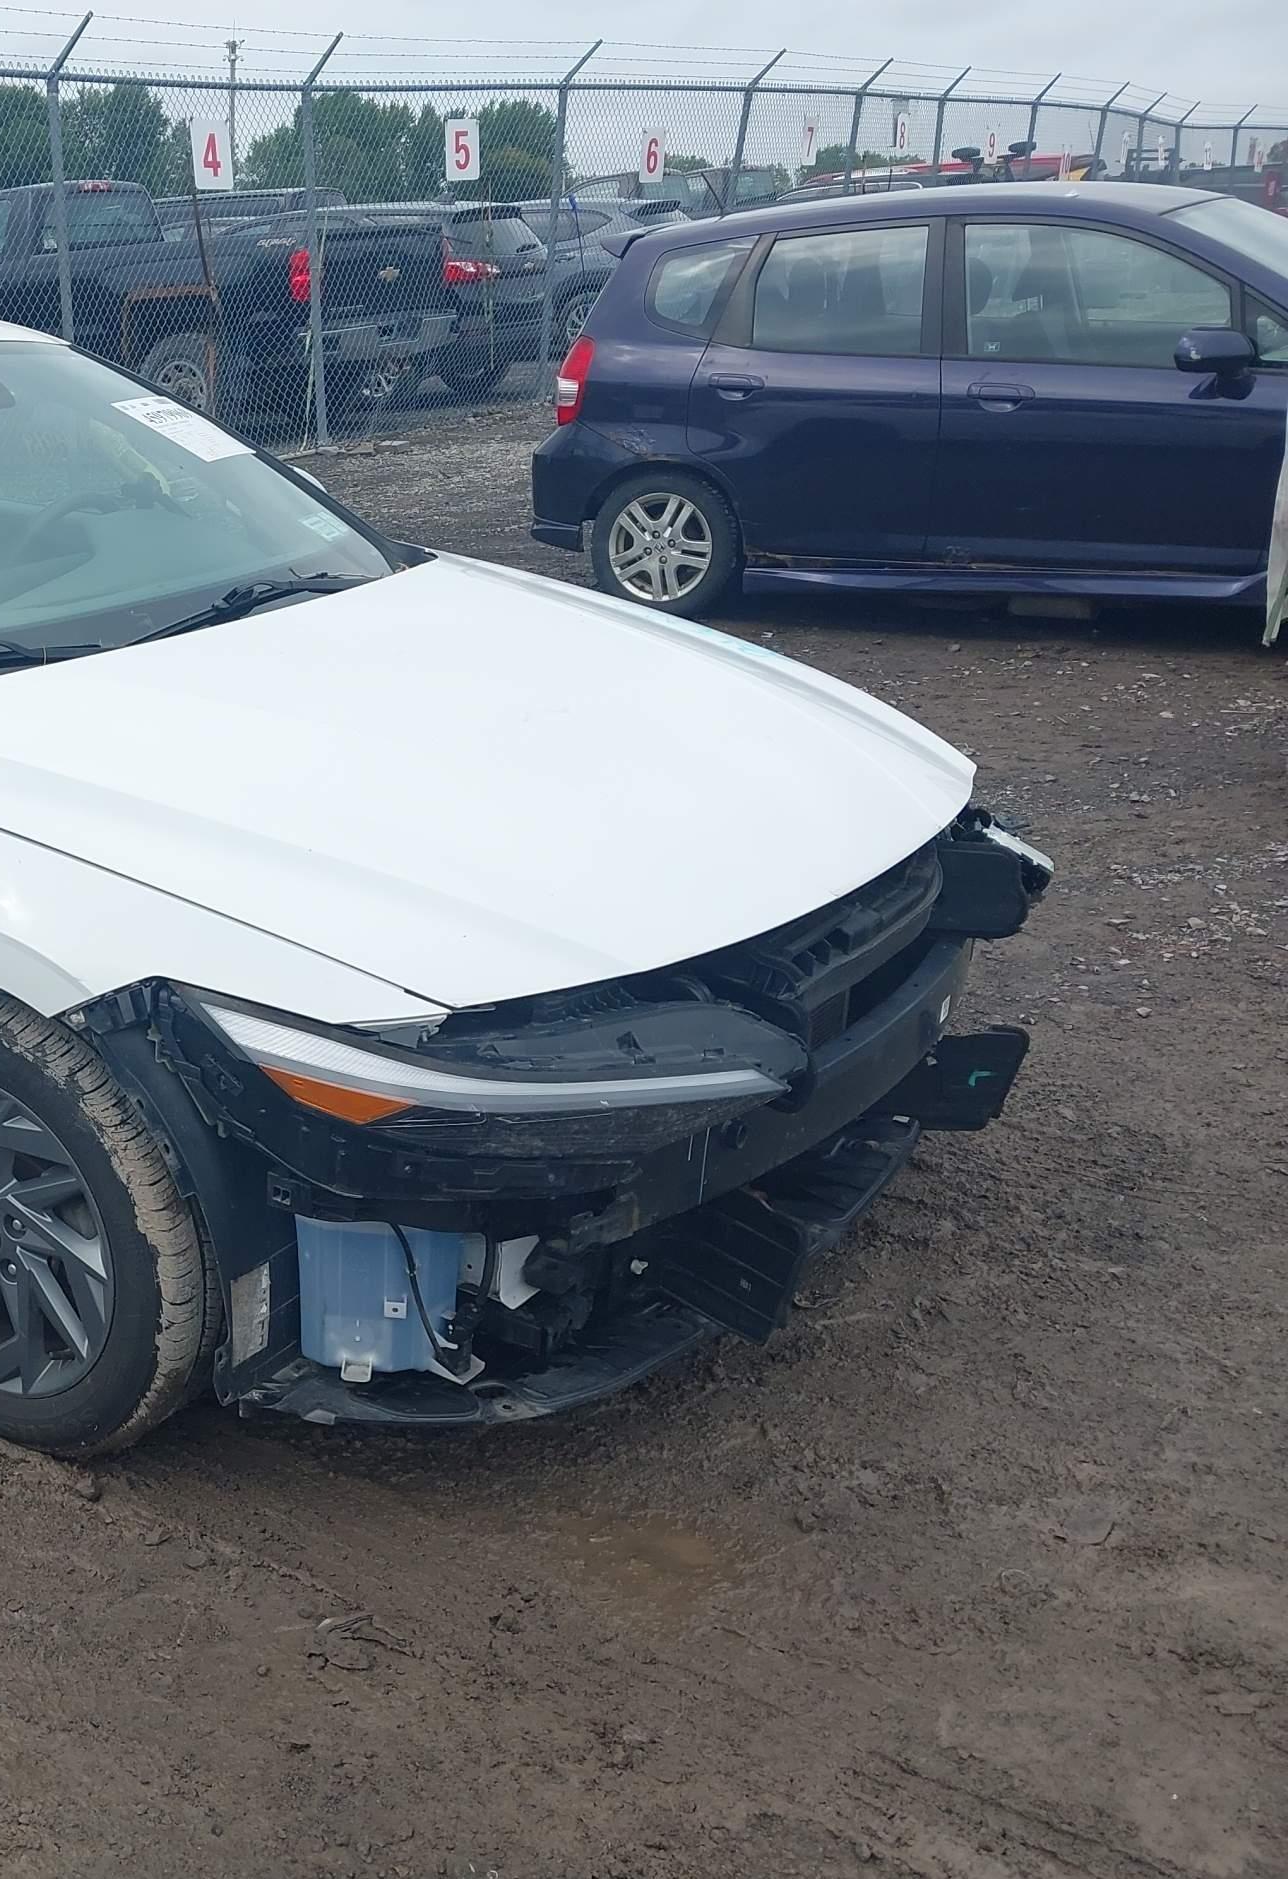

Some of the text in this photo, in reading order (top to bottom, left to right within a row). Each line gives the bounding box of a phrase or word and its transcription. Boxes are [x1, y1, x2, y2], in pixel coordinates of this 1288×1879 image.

[454, 130, 470, 170] 5
[807, 126, 815, 158] 7
[899, 121, 906, 149] 8
[989, 132, 995, 157] 9
[203, 132, 222, 177] 4
[646, 137, 659, 174] 6
